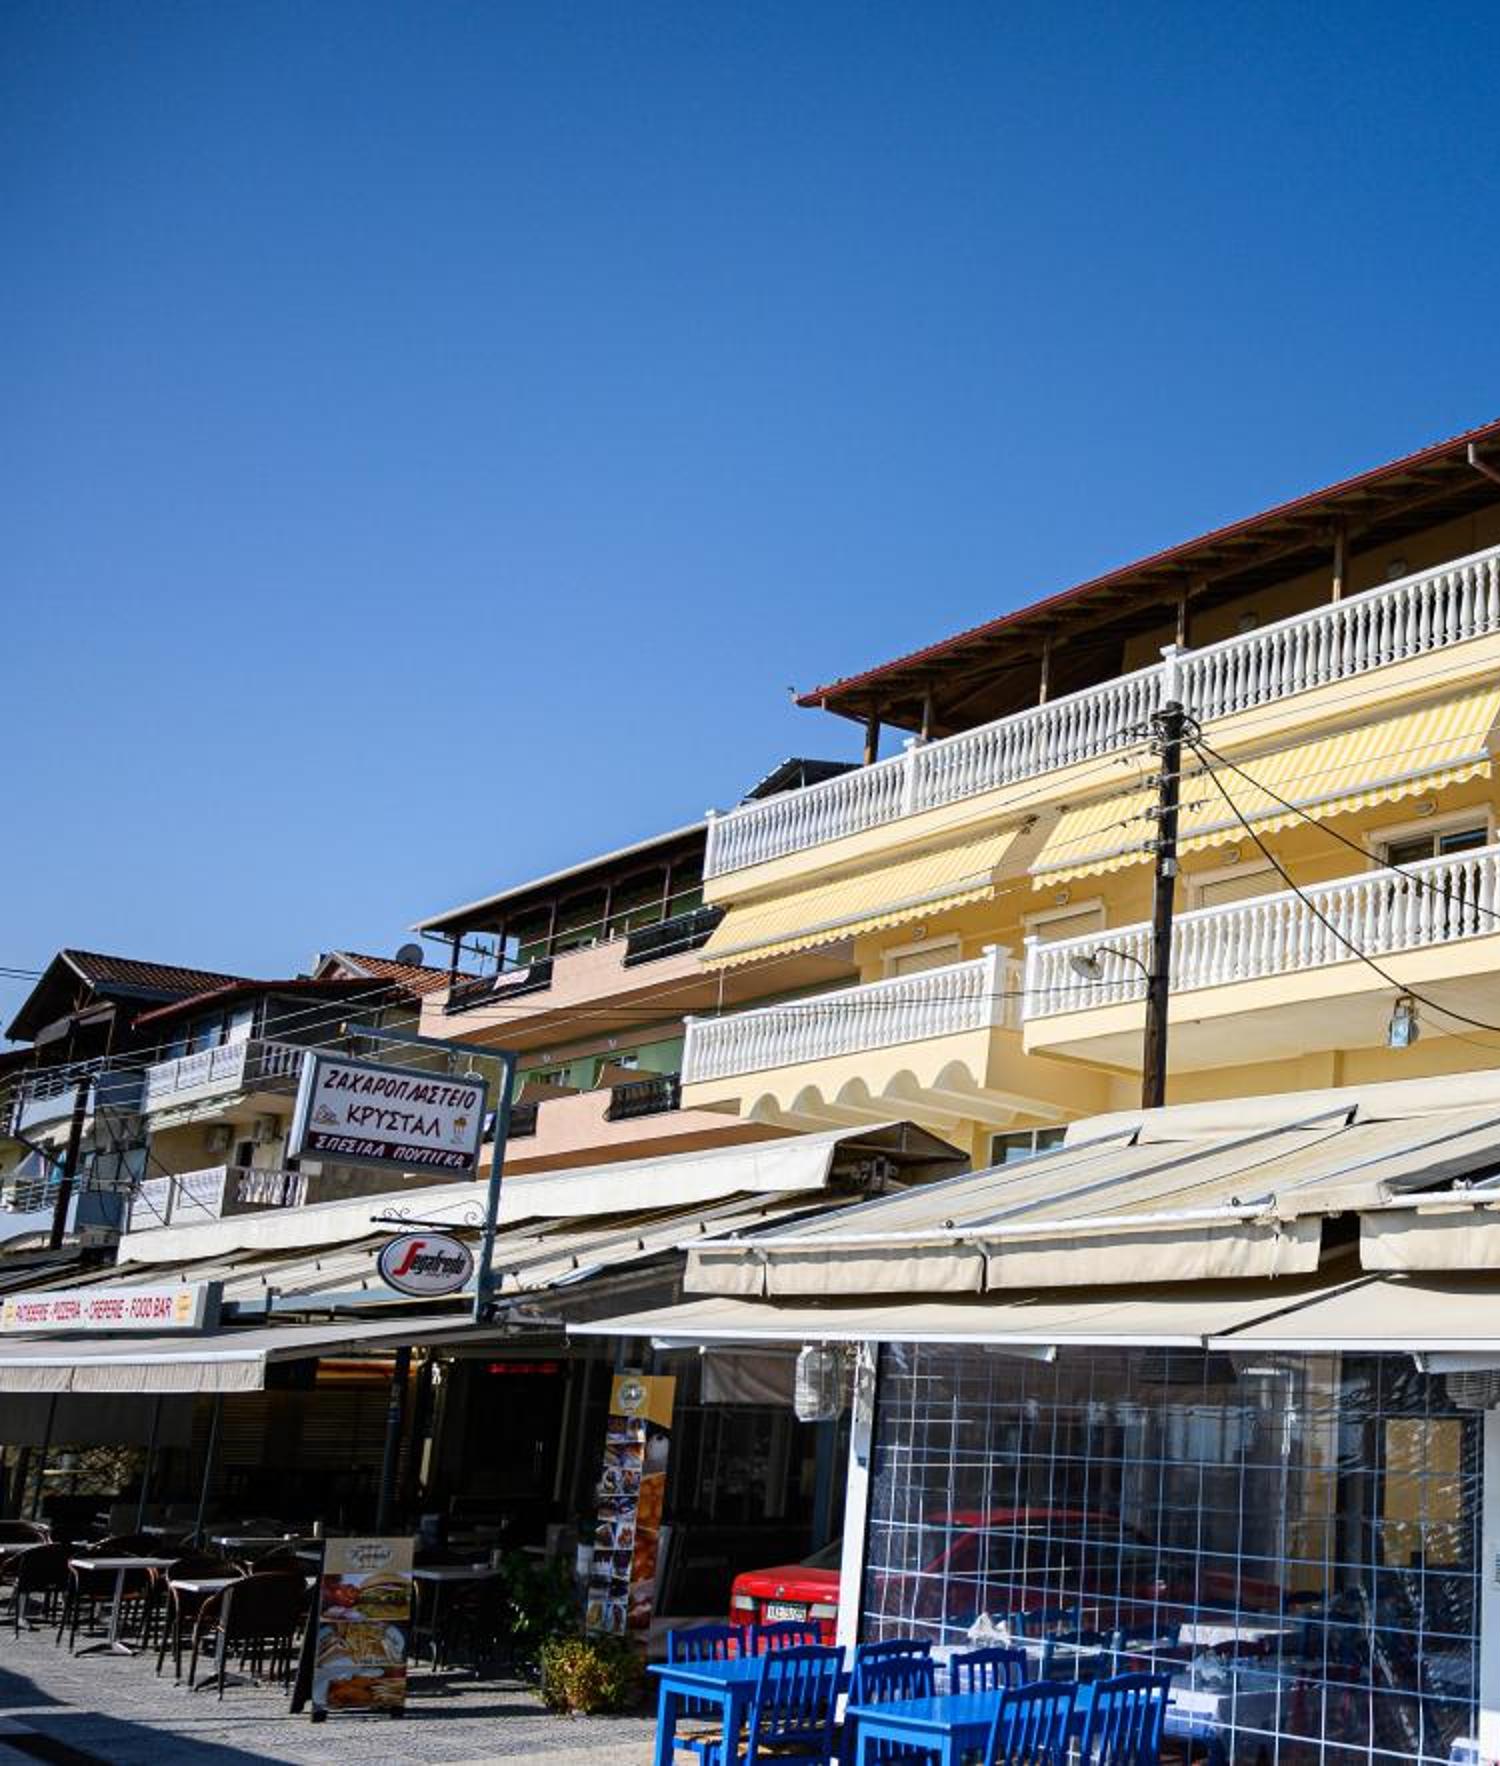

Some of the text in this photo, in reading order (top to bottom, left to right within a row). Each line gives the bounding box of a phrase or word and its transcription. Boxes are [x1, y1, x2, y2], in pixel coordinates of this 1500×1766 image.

[323, 1069, 477, 1110] ΖΑΧΑΡΟΠΛΑΣΤΕΙΟ
[346, 1103, 441, 1138] ΚΡΥΣΤΑΛ
[315, 1134, 386, 1158] ΣΠΕΣΙΑΛ
[129, 1297, 152, 1318] FOOD
[152, 1297, 173, 1318] BAR
